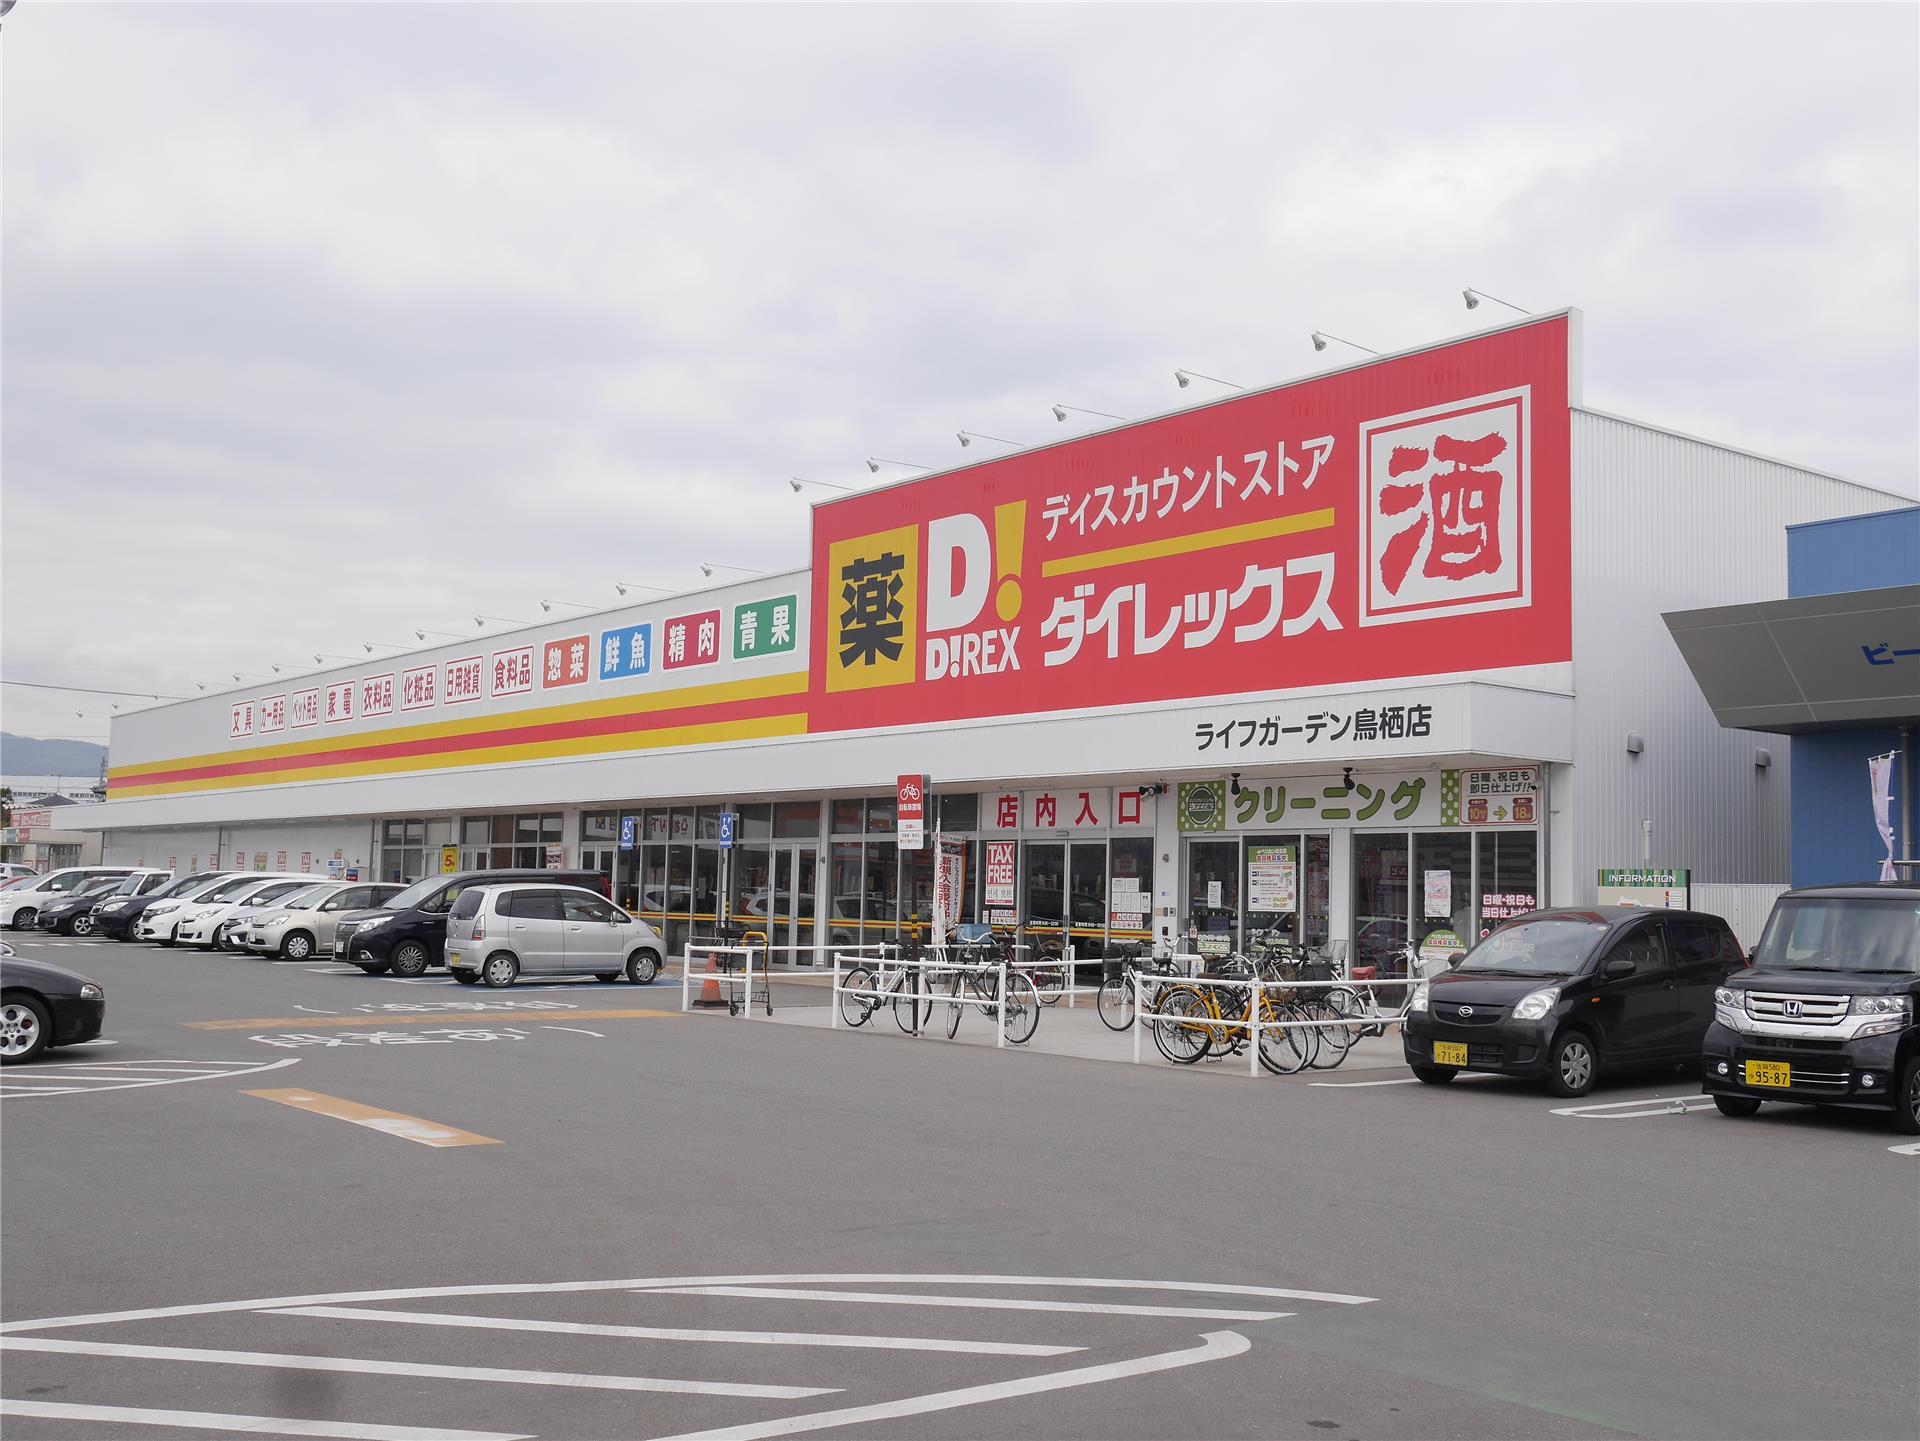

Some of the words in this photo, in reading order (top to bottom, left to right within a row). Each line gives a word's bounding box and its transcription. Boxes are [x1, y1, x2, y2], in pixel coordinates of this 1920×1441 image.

[1042, 435, 1337, 541] ディスカウントストア
[1379, 432, 1508, 597] 酒
[839, 552, 905, 669] 薬
[1041, 551, 1344, 668] ダイレックス
[668, 618, 714, 663] 精肉
[739, 605, 790, 651] 青果
[547, 643, 584, 682] 惣菜
[604, 632, 646, 673] 鮮魚
[925, 628, 1022, 681] D!REX
[403, 672, 434, 704] 化粧品
[446, 665, 480, 697] 日用雑貨
[494, 654, 531, 691] 食料品
[292, 693, 317, 722] ペット用品
[328, 687, 352, 718] 家電
[363, 680, 392, 712] 衣料品
[232, 706, 252, 733] 文具
[260, 700, 285, 728] カー用品
[1195, 704, 1433, 751] ライフガーデン鳥栖店
[1470, 771, 1530, 783] 日曜、祝日も
[996, 791, 1142, 829] 店内入口
[1234, 777, 1427, 824] クリーニング
[988, 844, 1013, 864] TAX
[987, 864, 1012, 884] FREE
[1608, 874, 1677, 883] INFORMATION
[1441, 1051, 1466, 1063] 71-84
[1755, 1071, 1788, 1085] 95-87
